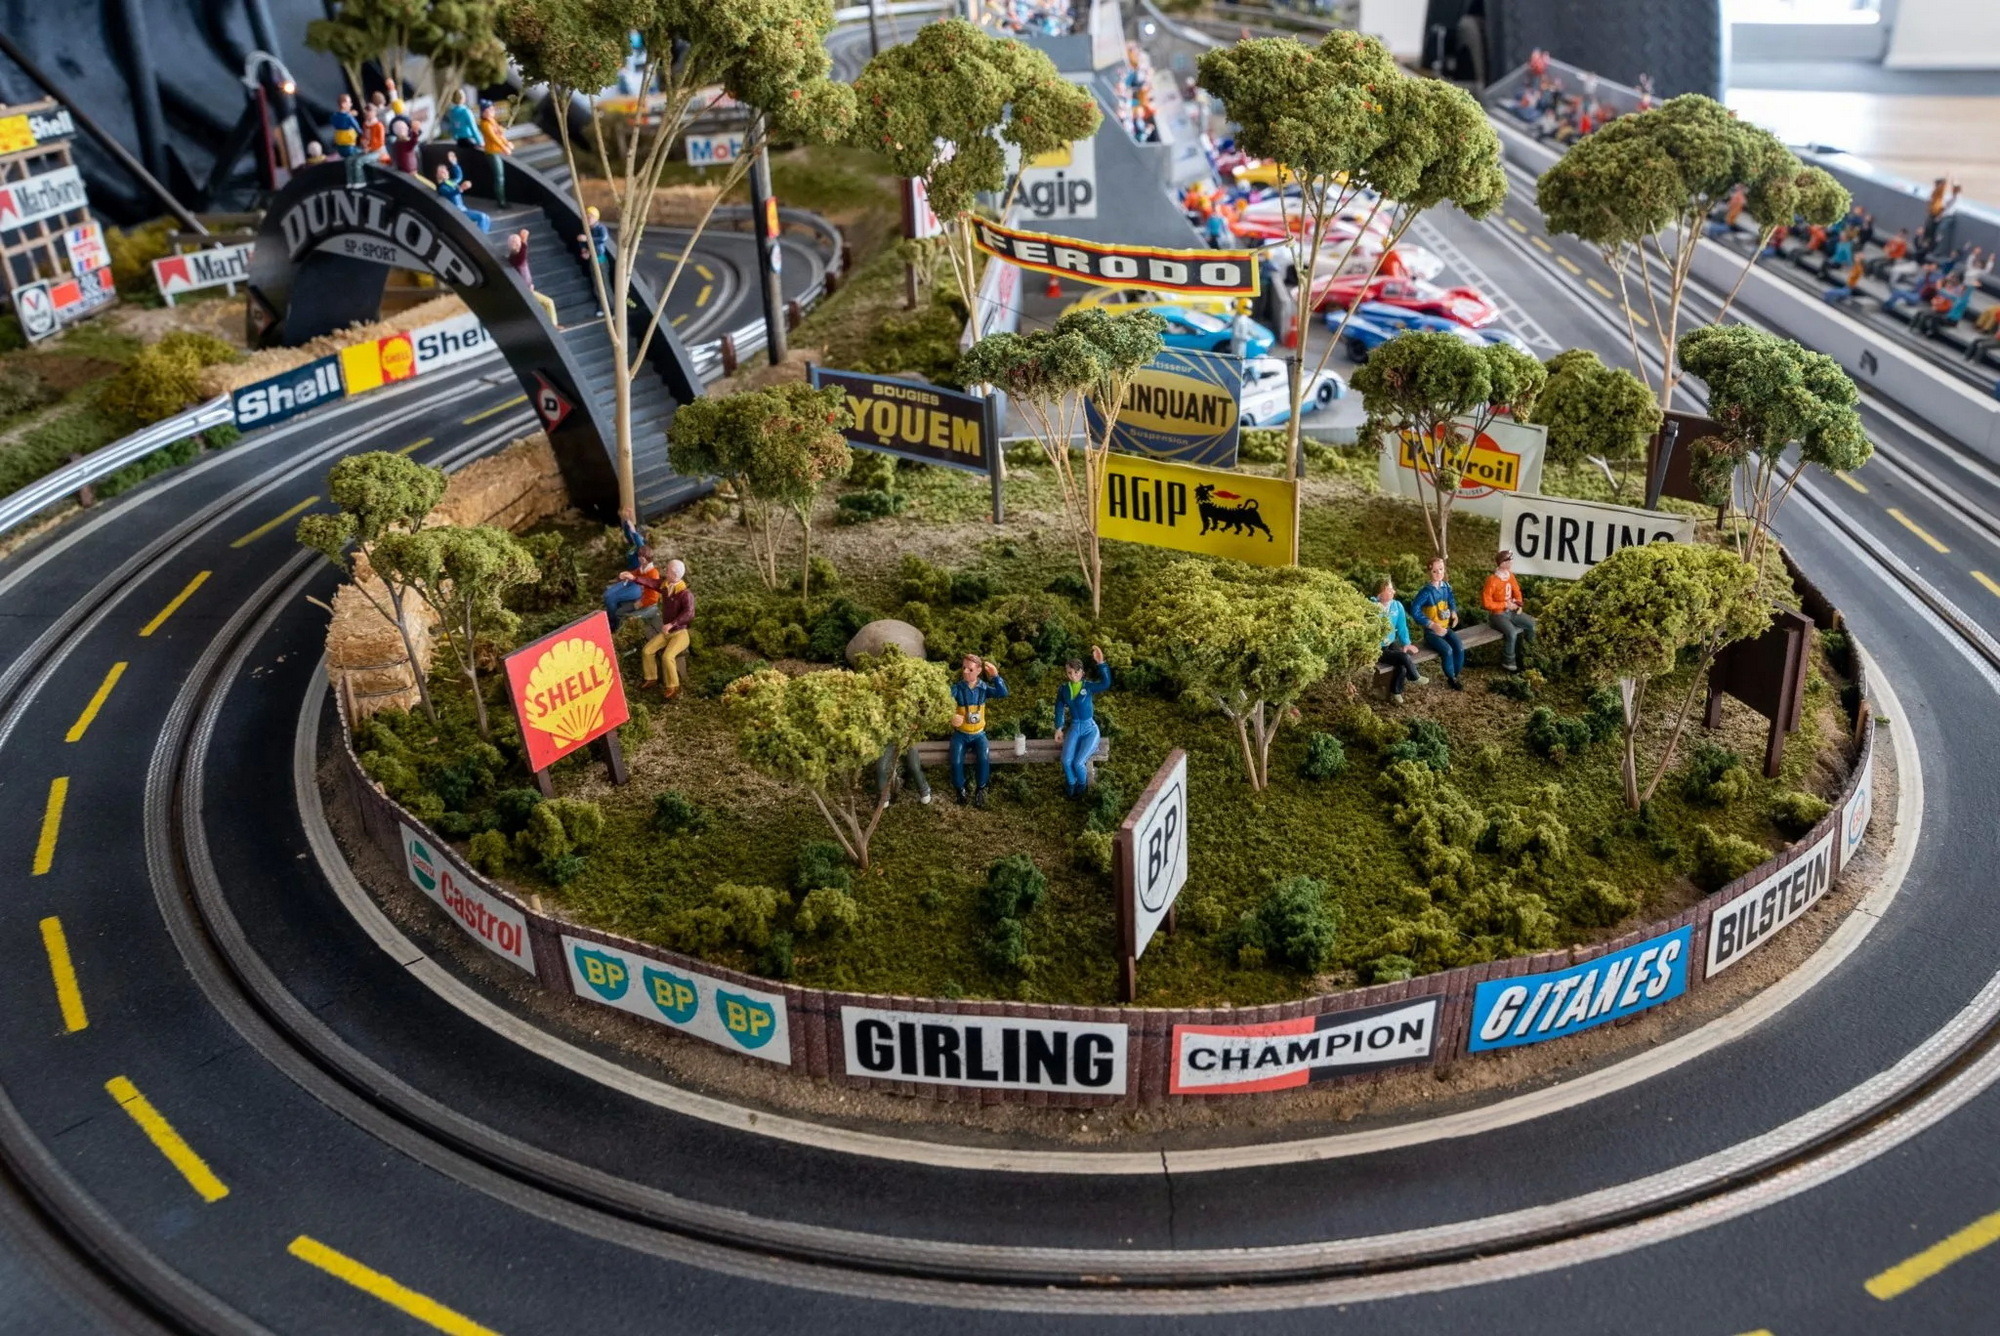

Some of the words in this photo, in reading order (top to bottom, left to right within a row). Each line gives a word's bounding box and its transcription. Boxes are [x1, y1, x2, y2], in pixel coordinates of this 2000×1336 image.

[691, 138, 743, 161] Mob
[1000, 171, 1093, 217] Agip
[280, 189, 477, 287] DUNLOP
[978, 226, 1241, 287] FERODO
[417, 324, 488, 363] Shel
[237, 362, 341, 425] Shell
[544, 397, 558, 411] D
[872, 384, 940, 407] BOUGIES
[843, 395, 982, 457] YQUEM
[1108, 472, 1187, 527] AGIP
[1514, 511, 1676, 566] GIRLIN
[533, 664, 605, 718] SHELL
[1147, 804, 1177, 894] BP
[440, 870, 523, 958] Castrol
[1715, 845, 1829, 965] BILSTEIN
[584, 956, 625, 990] BP
[652, 977, 694, 1013] BP
[725, 1000, 771, 1037] BP
[1479, 938, 1682, 1042] GITANES
[855, 1018, 1114, 1088] GIRLING
[1187, 1018, 1425, 1071] CHAMPION
